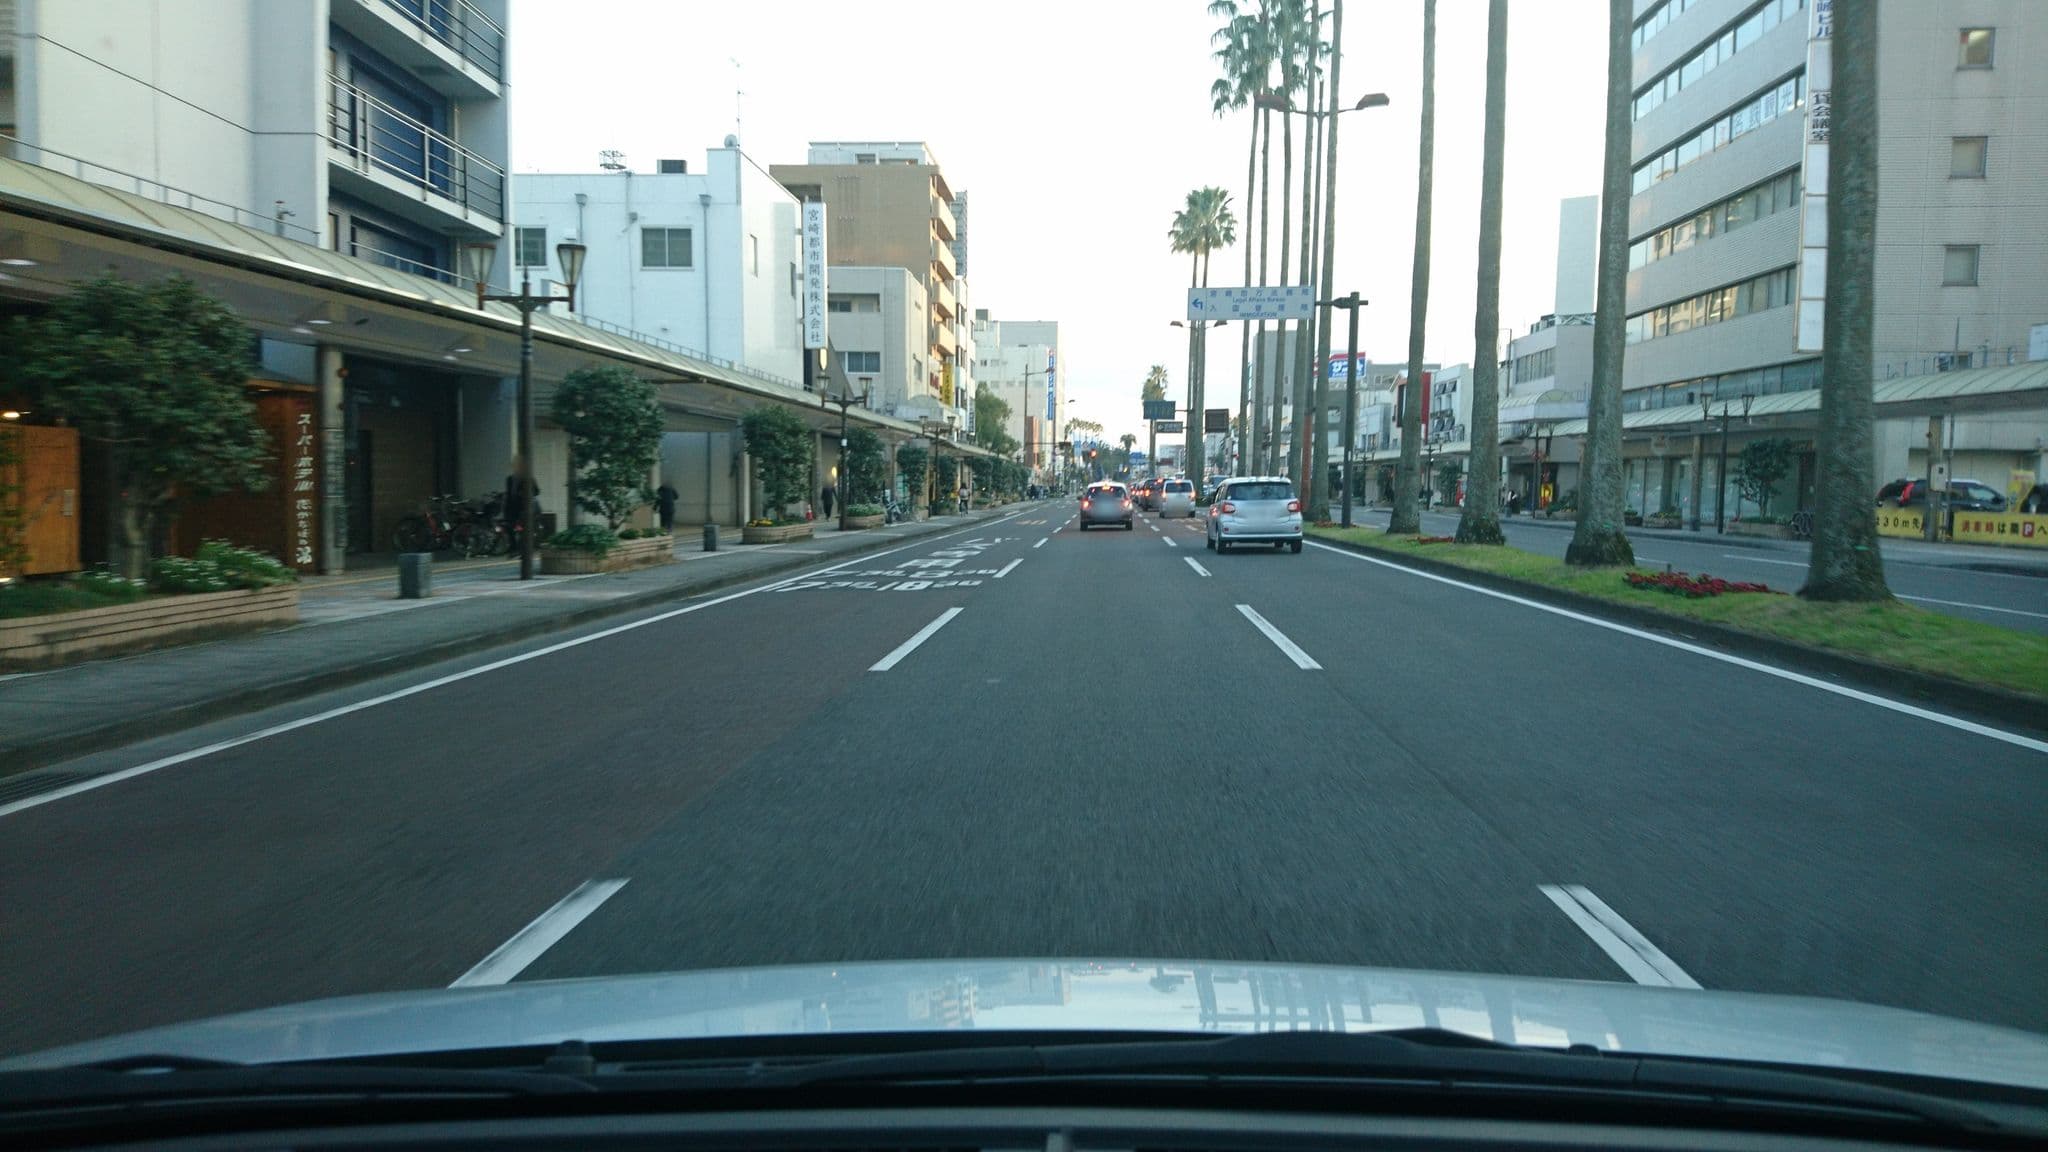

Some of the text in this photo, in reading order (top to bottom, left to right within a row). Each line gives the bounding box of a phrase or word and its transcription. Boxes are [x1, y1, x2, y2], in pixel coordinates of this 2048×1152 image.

[808, 209, 821, 343] 宮崎都市開発株式会社
[294, 413, 314, 492] スーパーホテル
